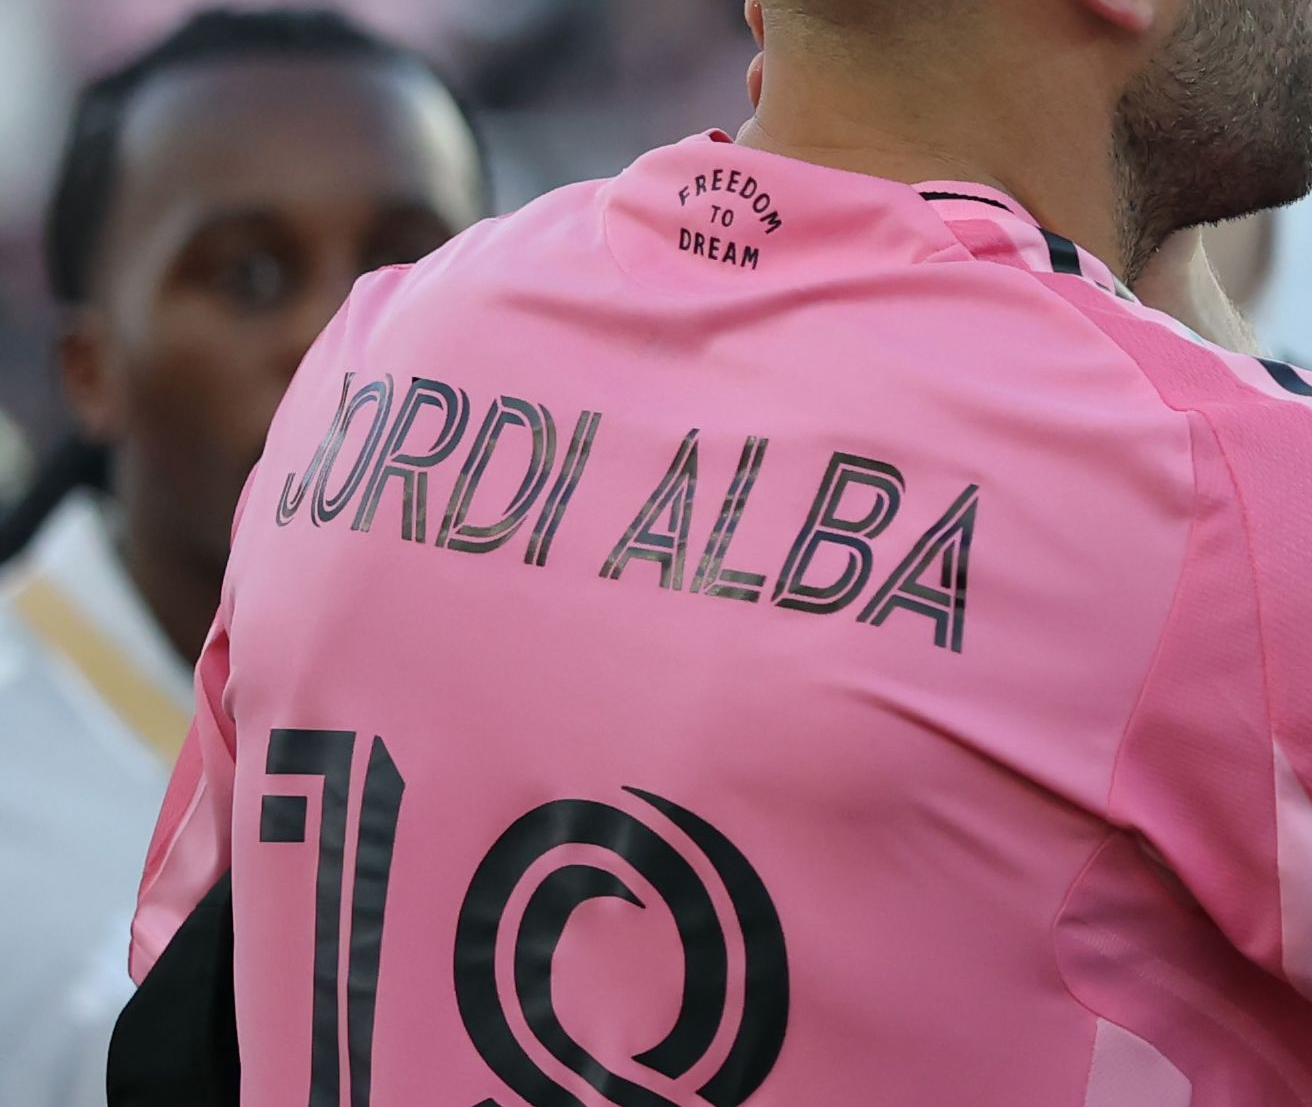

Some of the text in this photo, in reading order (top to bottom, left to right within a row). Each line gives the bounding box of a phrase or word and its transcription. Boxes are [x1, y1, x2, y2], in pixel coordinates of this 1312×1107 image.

[678, 169, 782, 234] FREEDOM
[710, 205, 734, 227] TO
[678, 228, 759, 270] DREAM
[275, 371, 980, 654] JORDI ALBA
